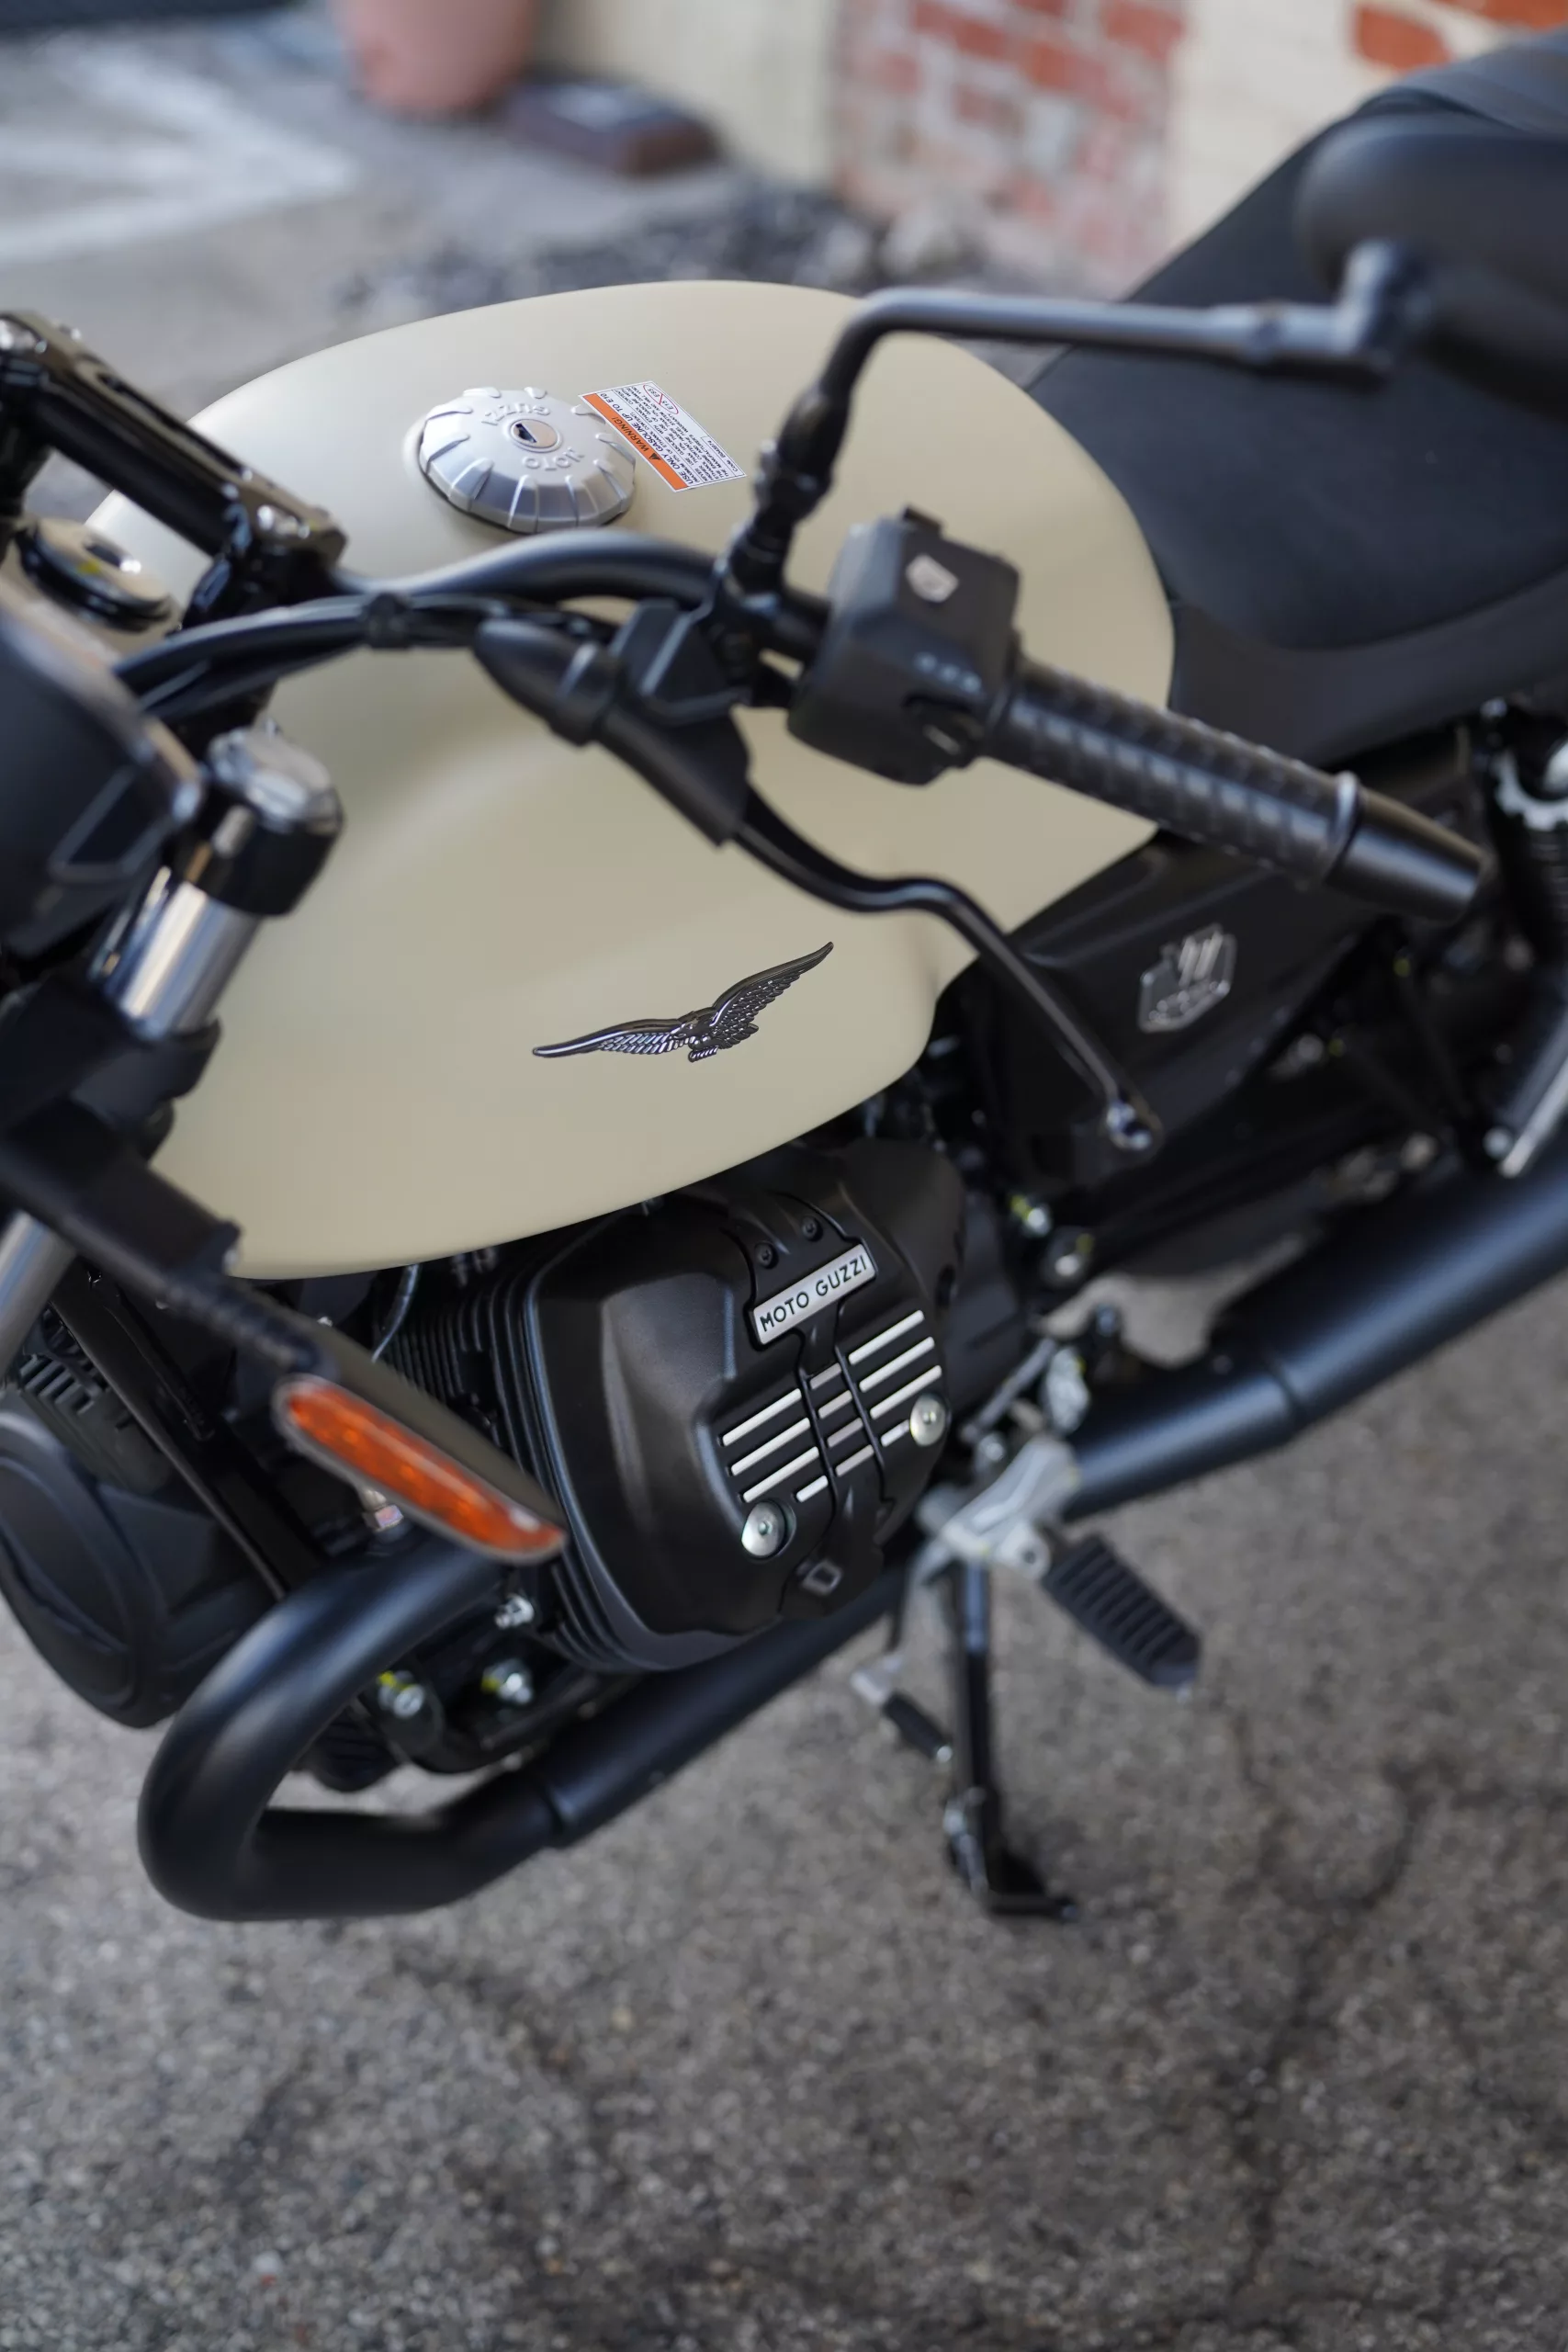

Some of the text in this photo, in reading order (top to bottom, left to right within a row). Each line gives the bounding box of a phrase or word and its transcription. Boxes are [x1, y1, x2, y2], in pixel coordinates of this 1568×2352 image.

[615, 390, 634, 404] CONTENT
[625, 388, 643, 401] DAMAGE
[647, 388, 673, 410] E15 E85
[631, 398, 651, 414] GASOLINE
[481, 402, 551, 426] GUZZI
[634, 407, 652, 423] ETHANOL
[658, 417, 671, 426] THAN
[659, 412, 675, 425] SYSTEM
[611, 416, 650, 451] WARNING!
[652, 424, 664, 434] WITH
[658, 423, 668, 431] USE
[668, 427, 684, 441] HIGHER
[674, 426, 685, 435] FUEL
[599, 392, 694, 484] USE ONLY GASOLINE UP TO E10
[648, 431, 667, 447] ETHANOL
[663, 436, 684, 455] GASOLINE
[682, 442, 702, 459] CONTENT
[688, 434, 722, 468] MANUFACTURER'S
[692, 445, 703, 453] AND
[686, 452, 698, 463] THAN
[700, 454, 716, 469] ENGINE
[694, 468, 708, 481] NEVER
[697, 465, 714, 480] HIGHER
[700, 461, 719, 479] ETHANOL
[715, 469, 724, 478] THE
[760, 1254, 867, 1332] MOTO GUZZI
